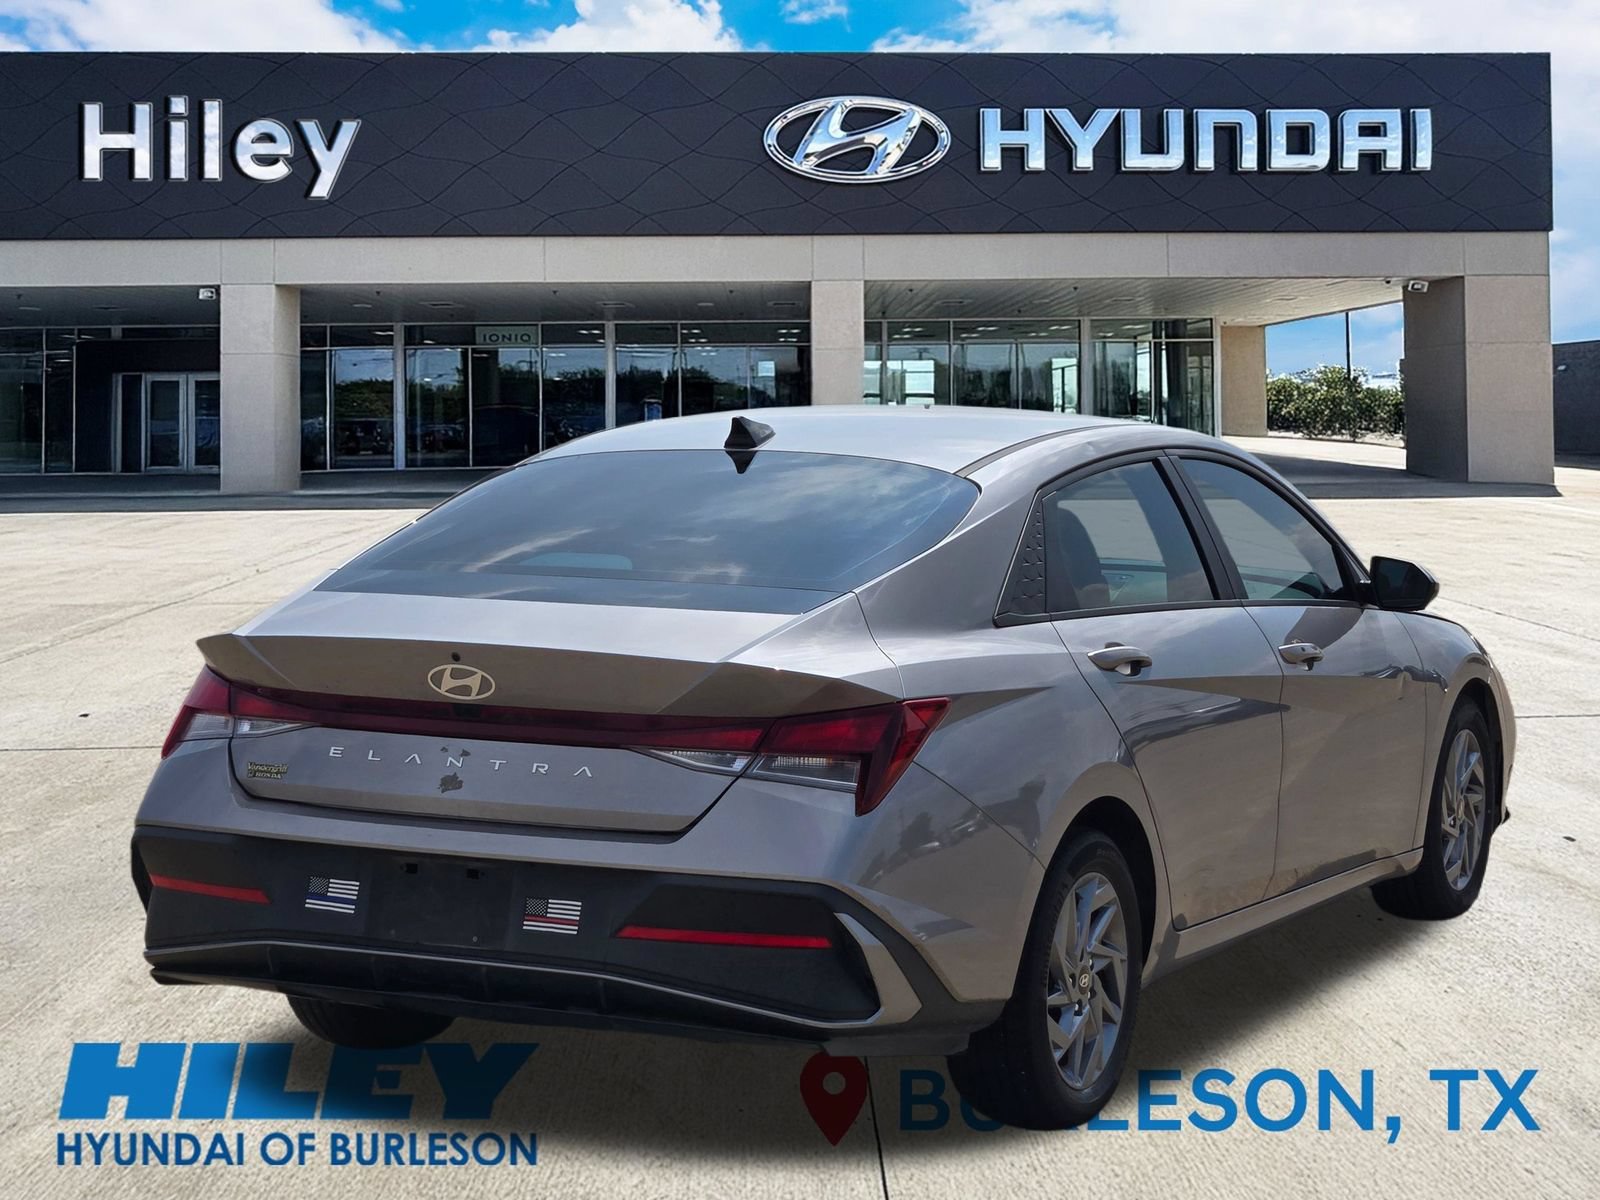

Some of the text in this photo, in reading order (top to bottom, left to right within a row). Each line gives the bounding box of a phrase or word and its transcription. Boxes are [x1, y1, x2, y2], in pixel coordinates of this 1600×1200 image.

[80, 95, 361, 200] Hiley
[978, 107, 1434, 172] HYUNDAI
[328, 745, 594, 778] ELANTRA
